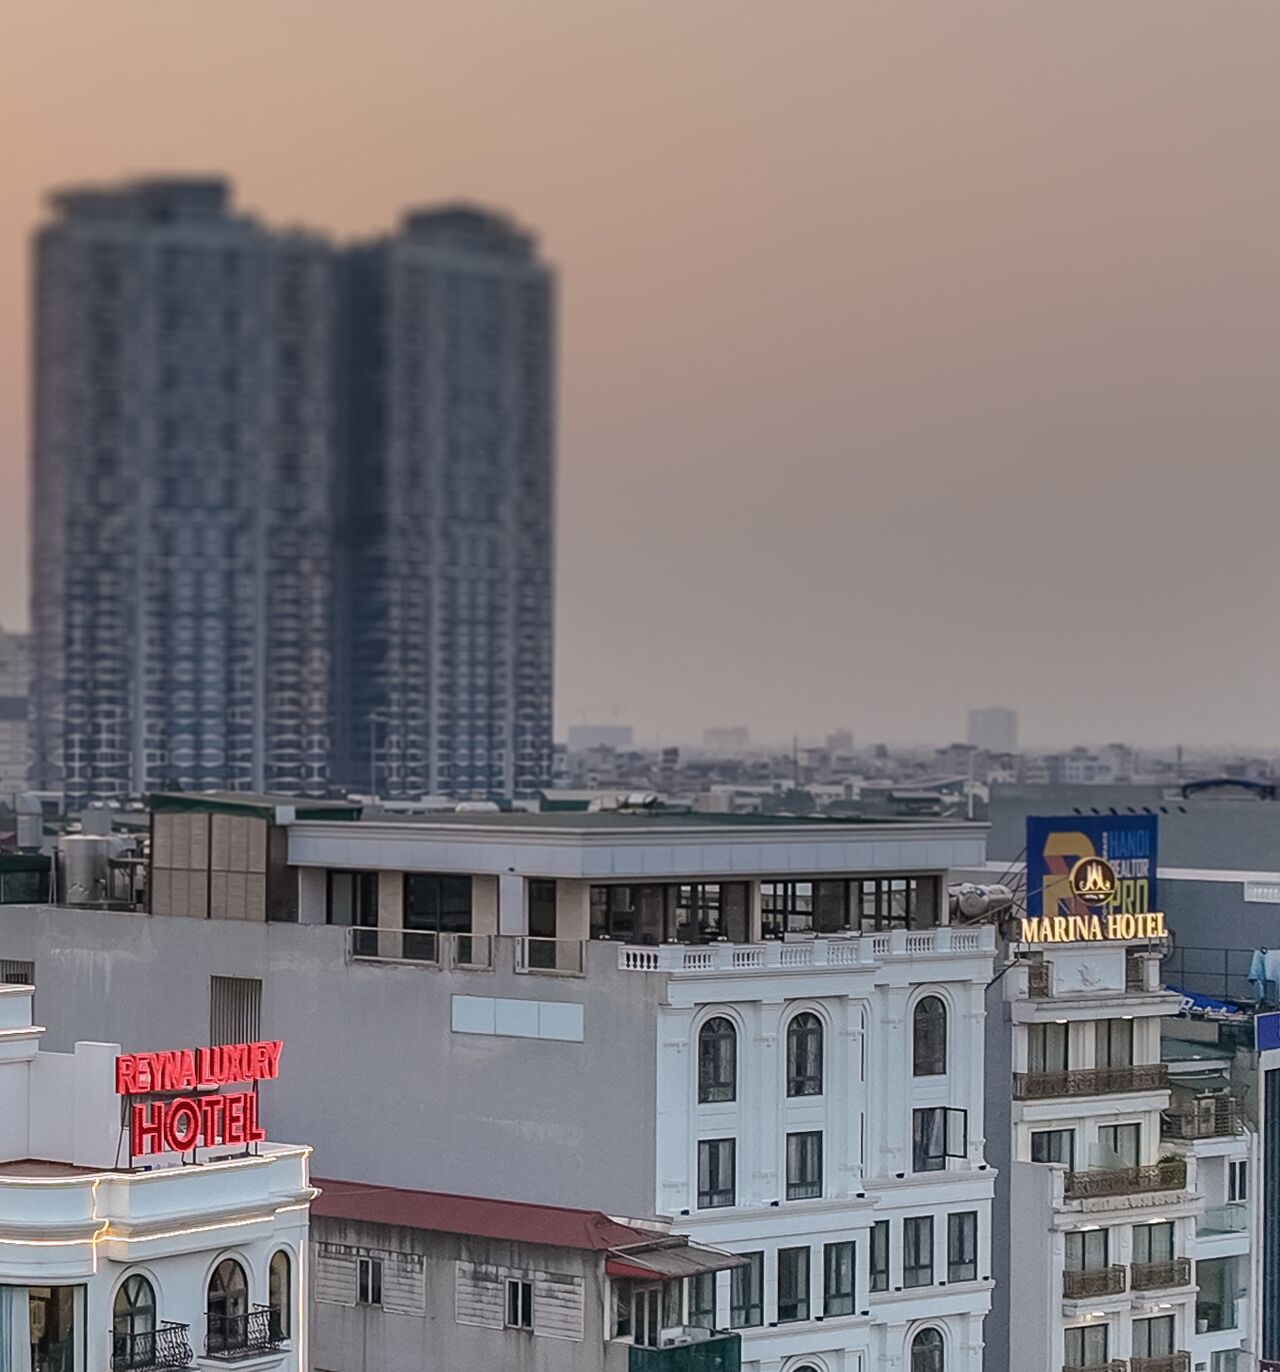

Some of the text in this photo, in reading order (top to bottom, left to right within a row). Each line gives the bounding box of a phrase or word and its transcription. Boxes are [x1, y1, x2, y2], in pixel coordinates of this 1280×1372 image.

[1022, 912, 1168, 942] MARINA HOTEL
[115, 1040, 283, 1095] REYNA LUXURY
[133, 1091, 265, 1157] HOTEL
